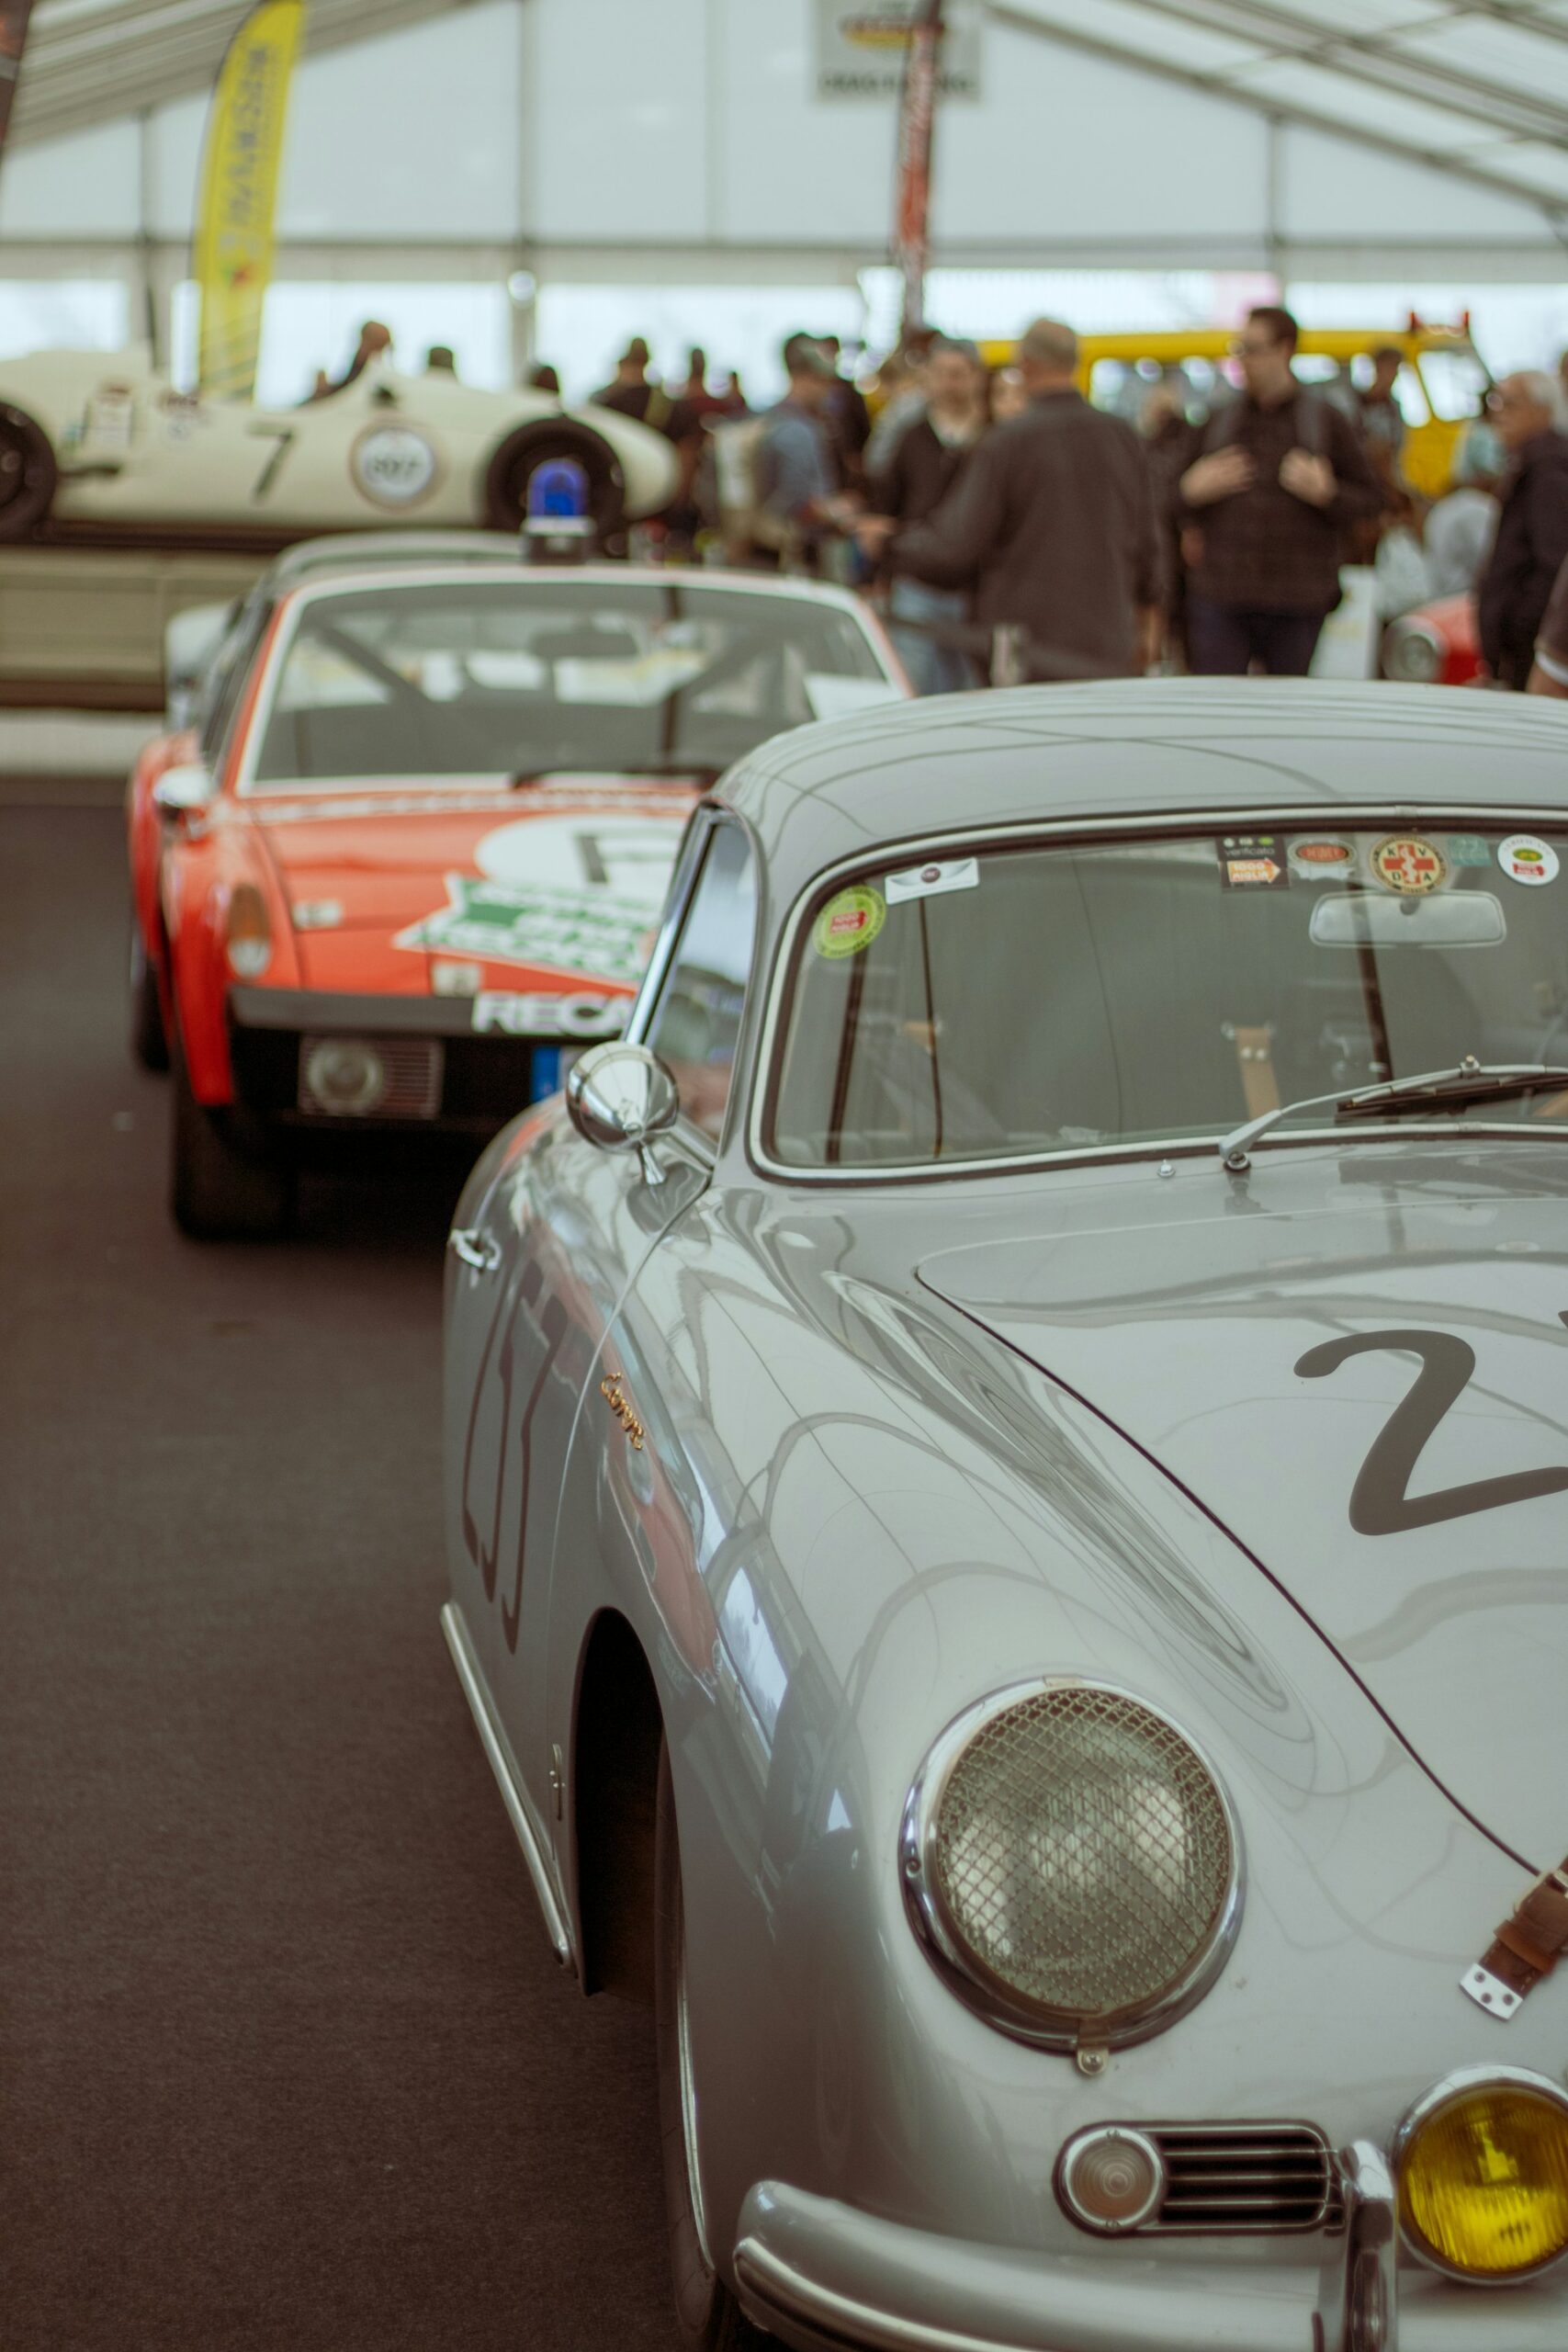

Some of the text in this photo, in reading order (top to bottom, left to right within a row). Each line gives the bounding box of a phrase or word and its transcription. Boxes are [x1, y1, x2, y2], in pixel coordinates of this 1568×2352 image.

[248, 423, 297, 503] 7
[1224, 846, 1275, 856] verificato
[1233, 862, 1265, 871] 1000
[1293, 1311, 1568, 1536] 2
